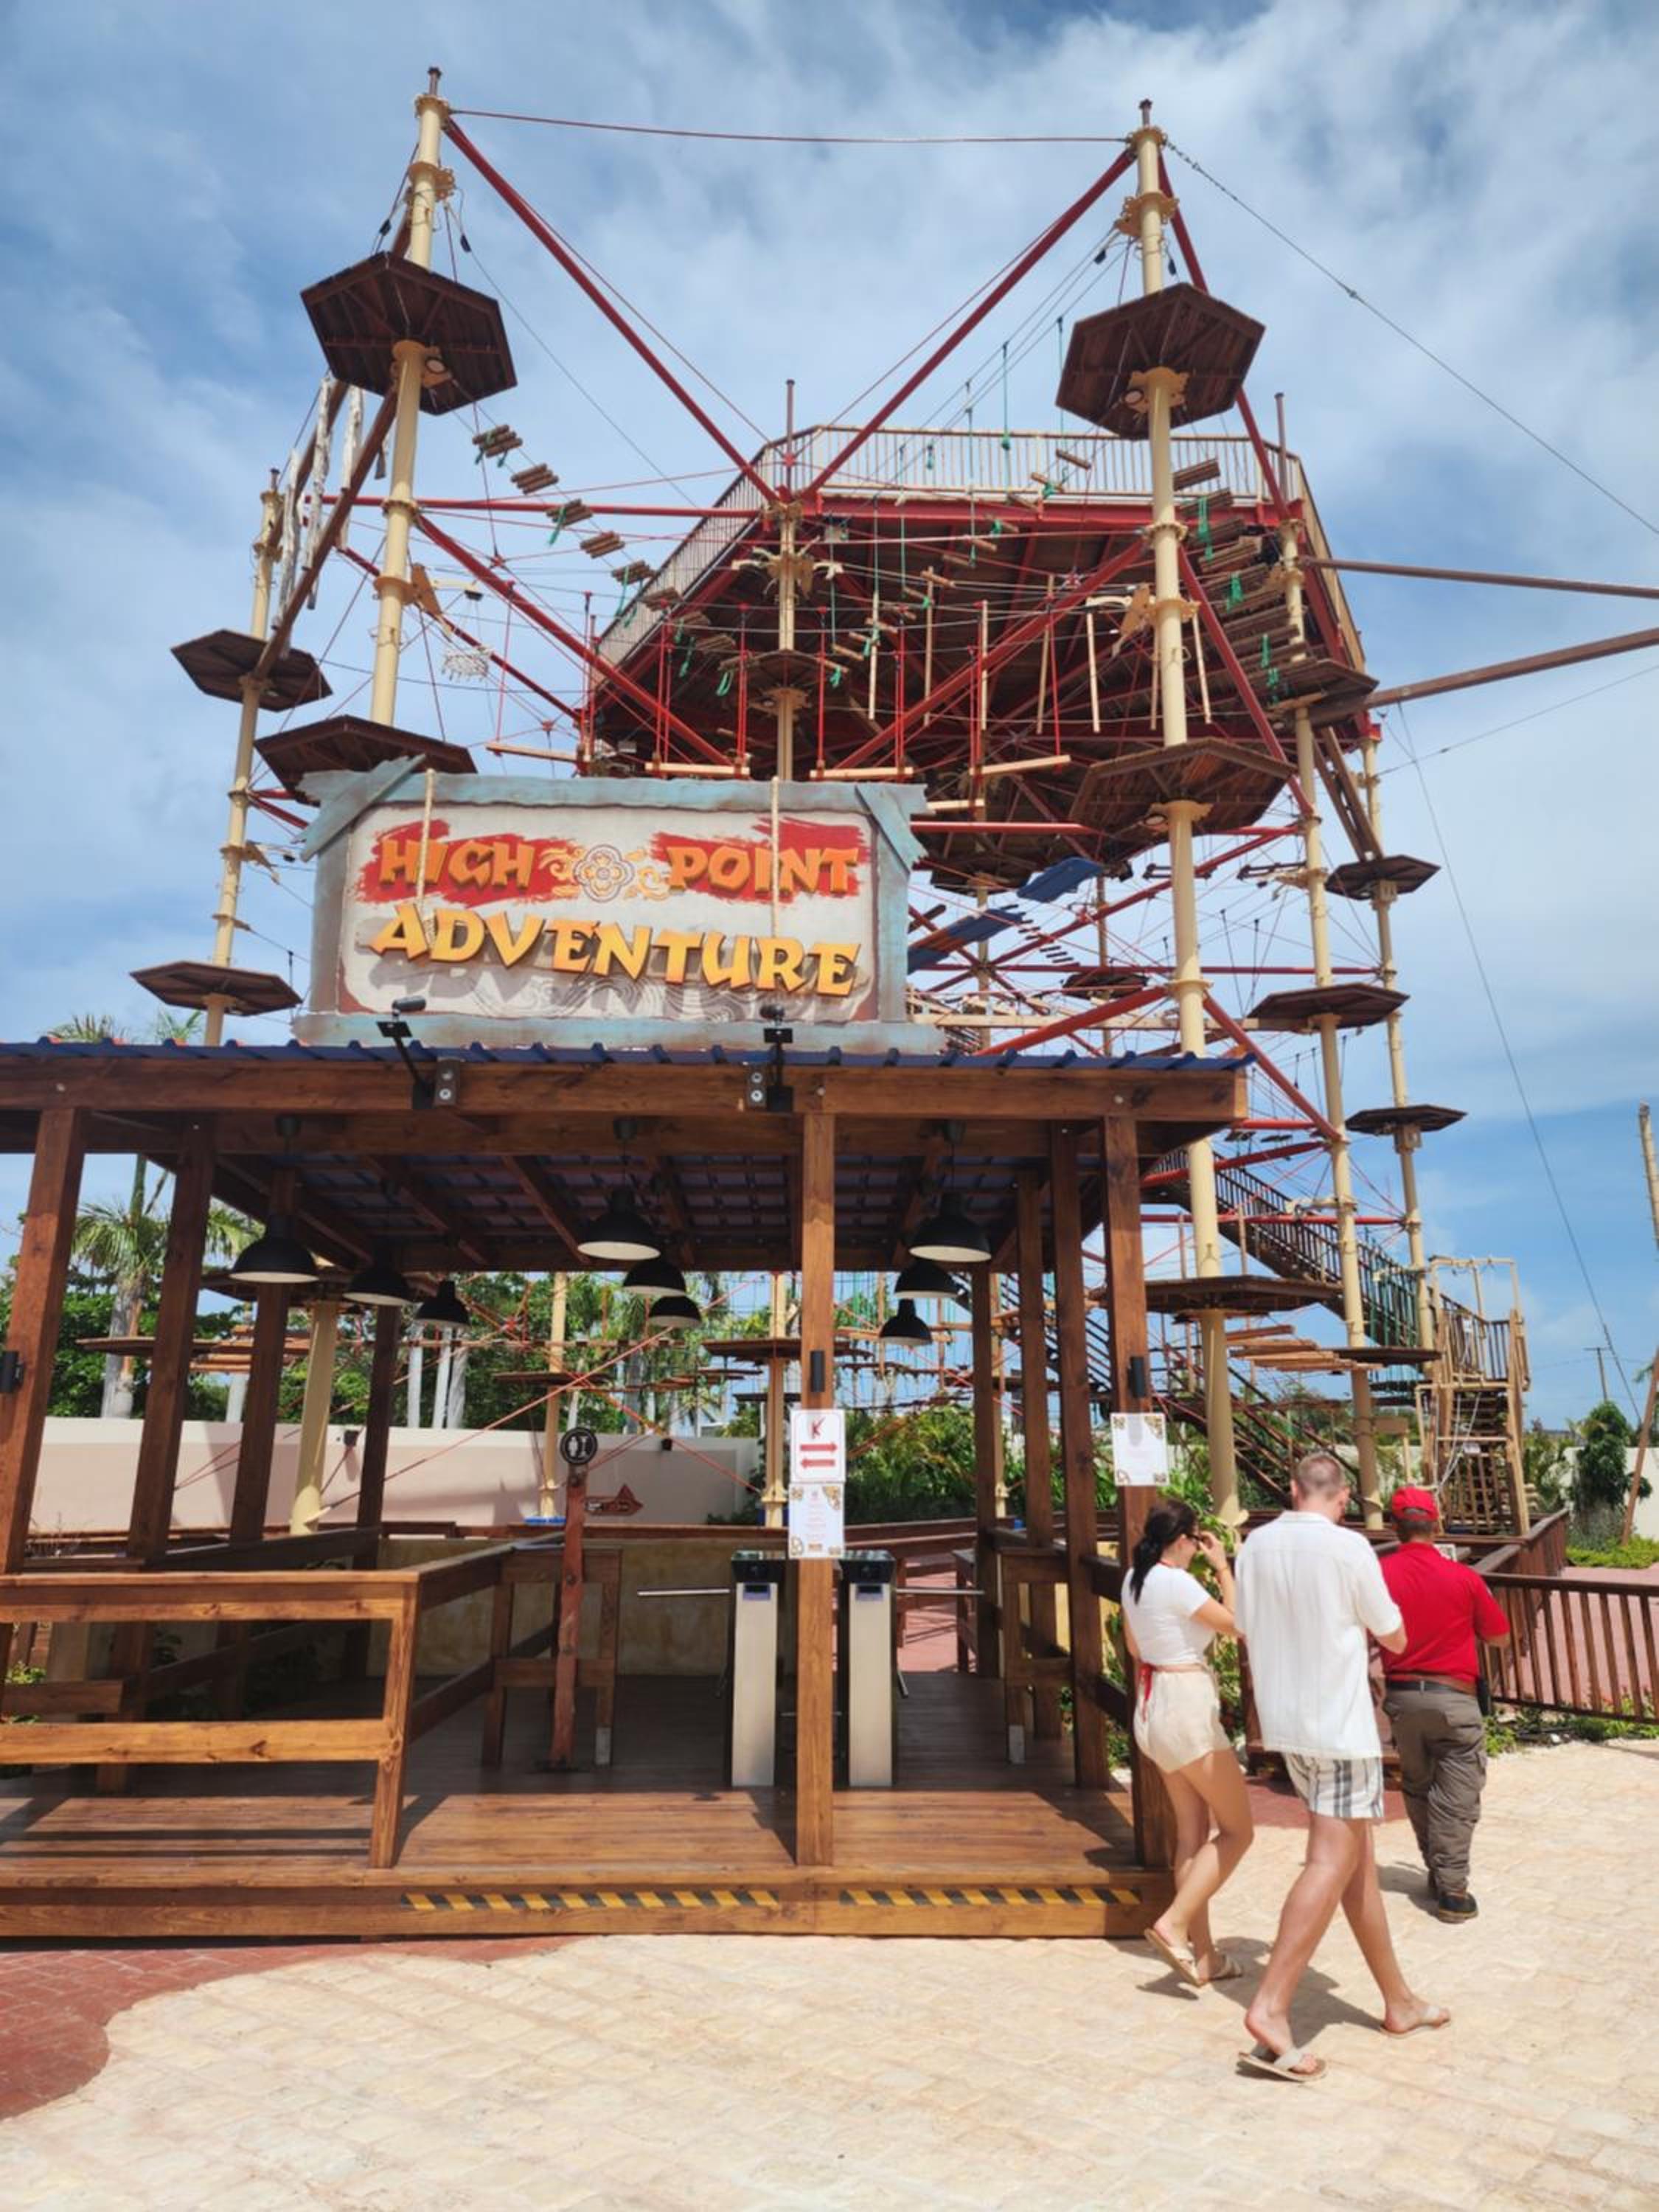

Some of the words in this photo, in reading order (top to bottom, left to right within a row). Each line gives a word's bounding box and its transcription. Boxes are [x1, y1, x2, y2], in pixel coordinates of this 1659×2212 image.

[378, 838, 535, 891] HIGH
[666, 846, 859, 894] POINT
[369, 902, 861, 997] ADVENTURE
